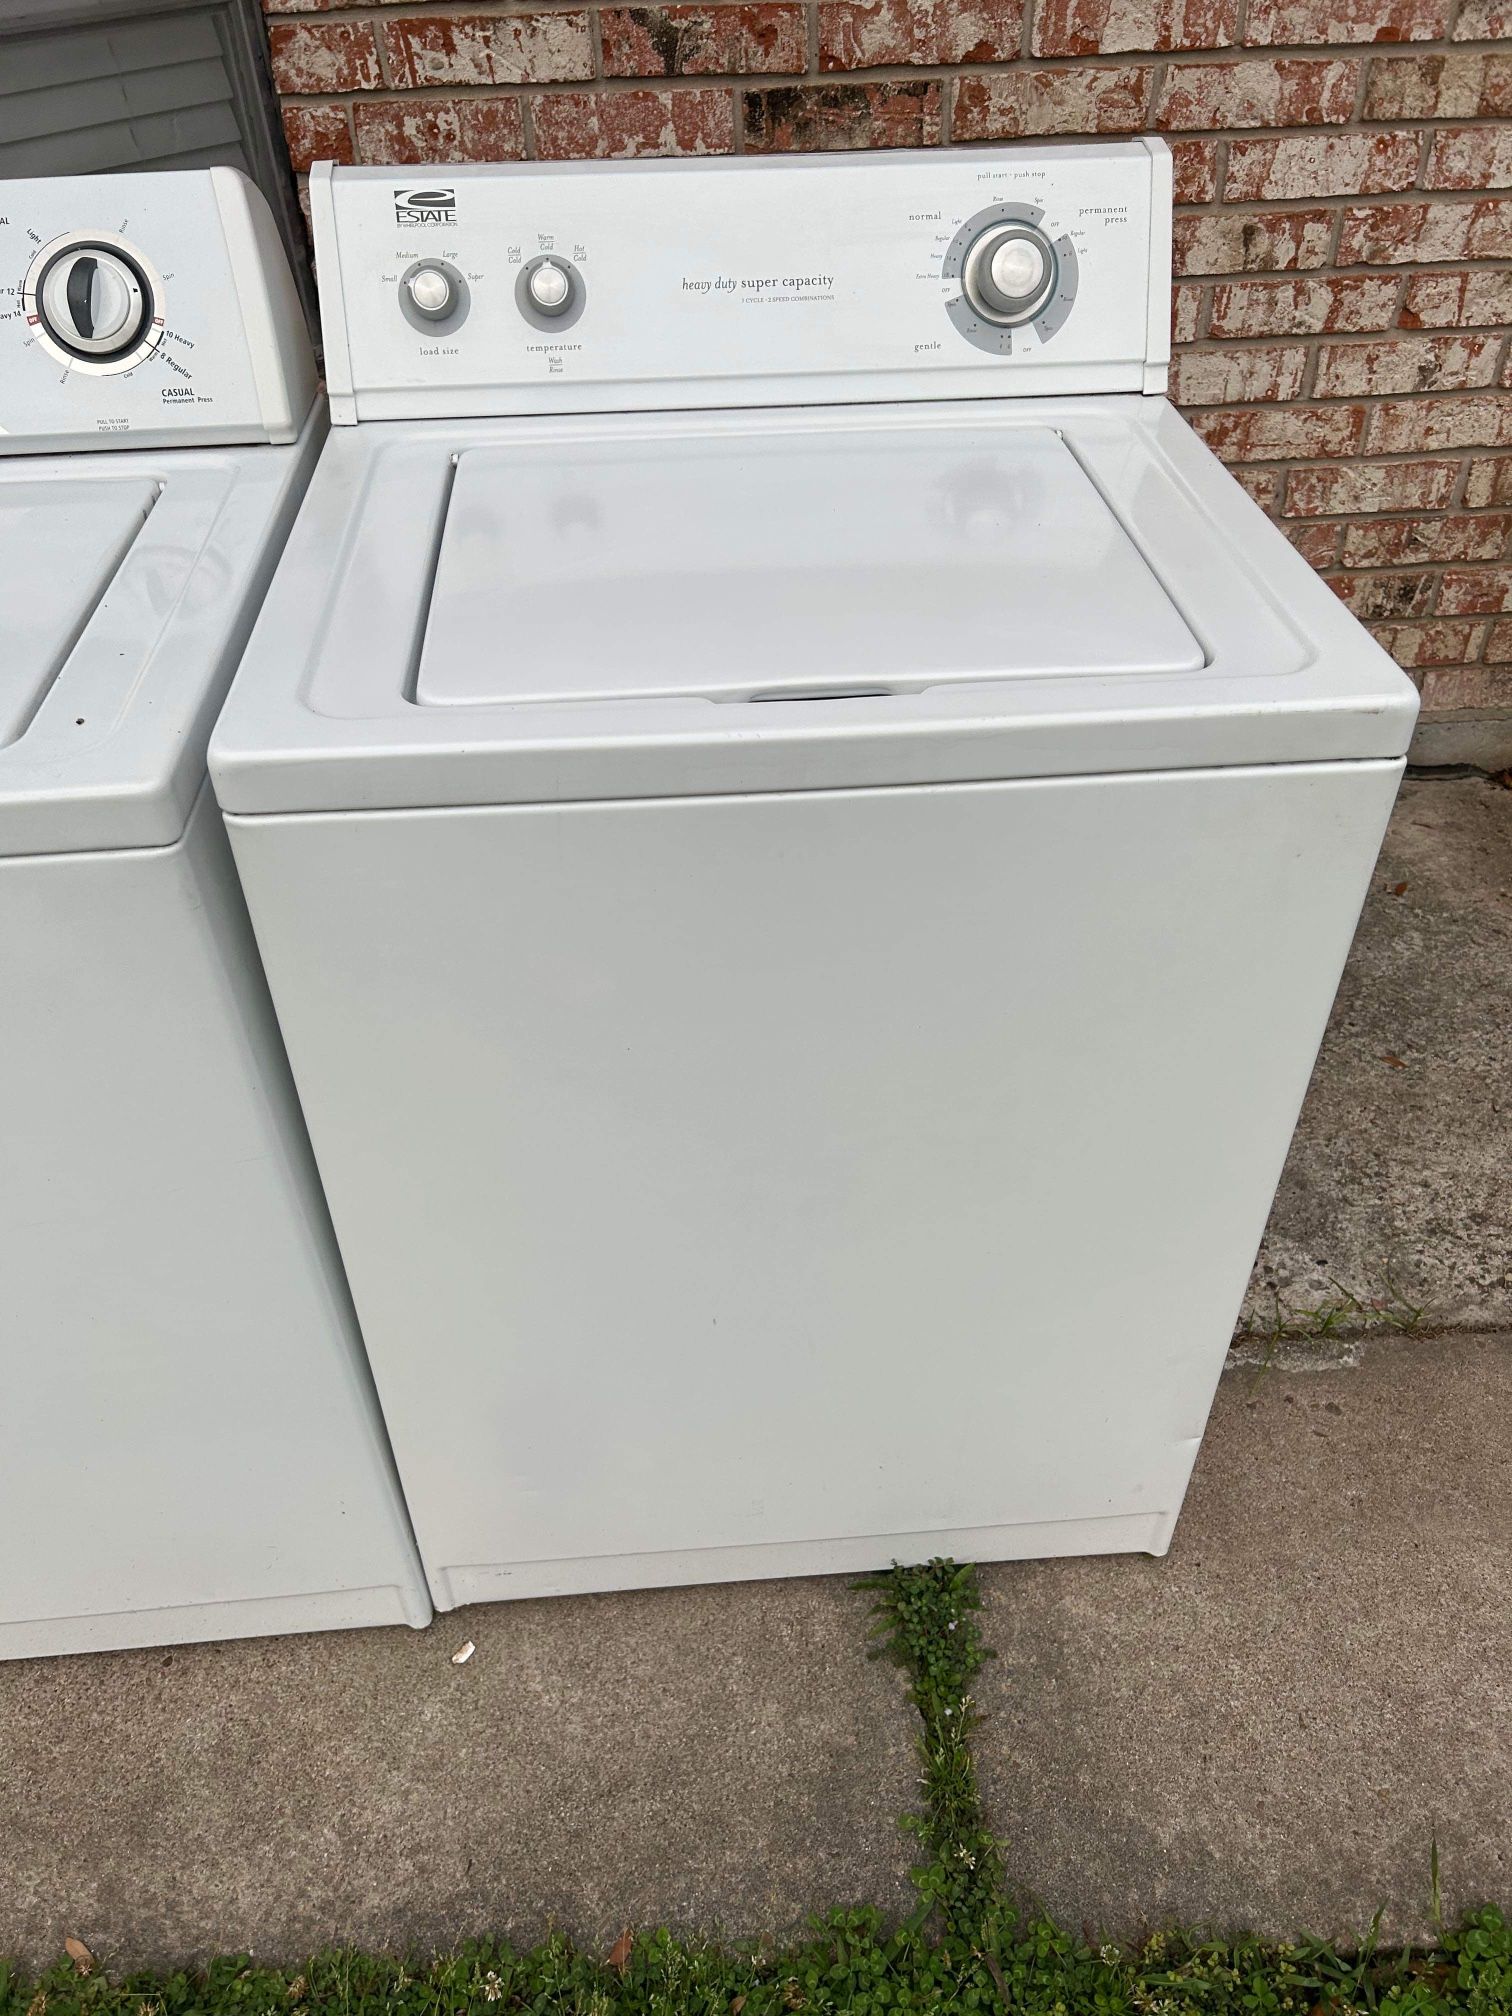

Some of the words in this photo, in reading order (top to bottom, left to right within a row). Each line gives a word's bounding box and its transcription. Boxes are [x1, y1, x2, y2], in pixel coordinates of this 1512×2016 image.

[977, 171, 990, 181] pull
[1014, 171, 1030, 180] push
[1031, 170, 1046, 179] stop
[909, 211, 942, 221] normal
[1079, 206, 1128, 216] permanent
[396, 210, 457, 223] ESTATE
[1105, 216, 1128, 226] press
[118, 218, 129, 234] Rinse
[26, 228, 42, 245] Light
[507, 246, 521, 254] Cold
[540, 243, 554, 251] Cold
[396, 251, 419, 259] Medium
[442, 250, 459, 259] Large
[573, 254, 587, 262] Cold
[508, 256, 522, 264] Cold
[162, 272, 175, 281] Spin
[467, 273, 484, 282] Super
[682, 277, 712, 294] heavy
[714, 276, 738, 293] duty
[741, 278, 779, 292] super
[782, 274, 834, 290] capacity
[7, 288, 15, 296] 12
[14, 310, 22, 318] 14
[23, 337, 36, 348] Spin
[166, 330, 174, 338] 10
[174, 334, 195, 349] Heavy
[420, 347, 439, 356] load
[443, 347, 459, 355] size
[526, 343, 582, 353] temperature
[914, 341, 942, 352] gentle
[160, 352, 166, 360] 8
[166, 356, 193, 380] Regular
[59, 369, 71, 385] Rinse
[161, 388, 195, 397] CASUAL
[163, 397, 195, 405] Permanent
